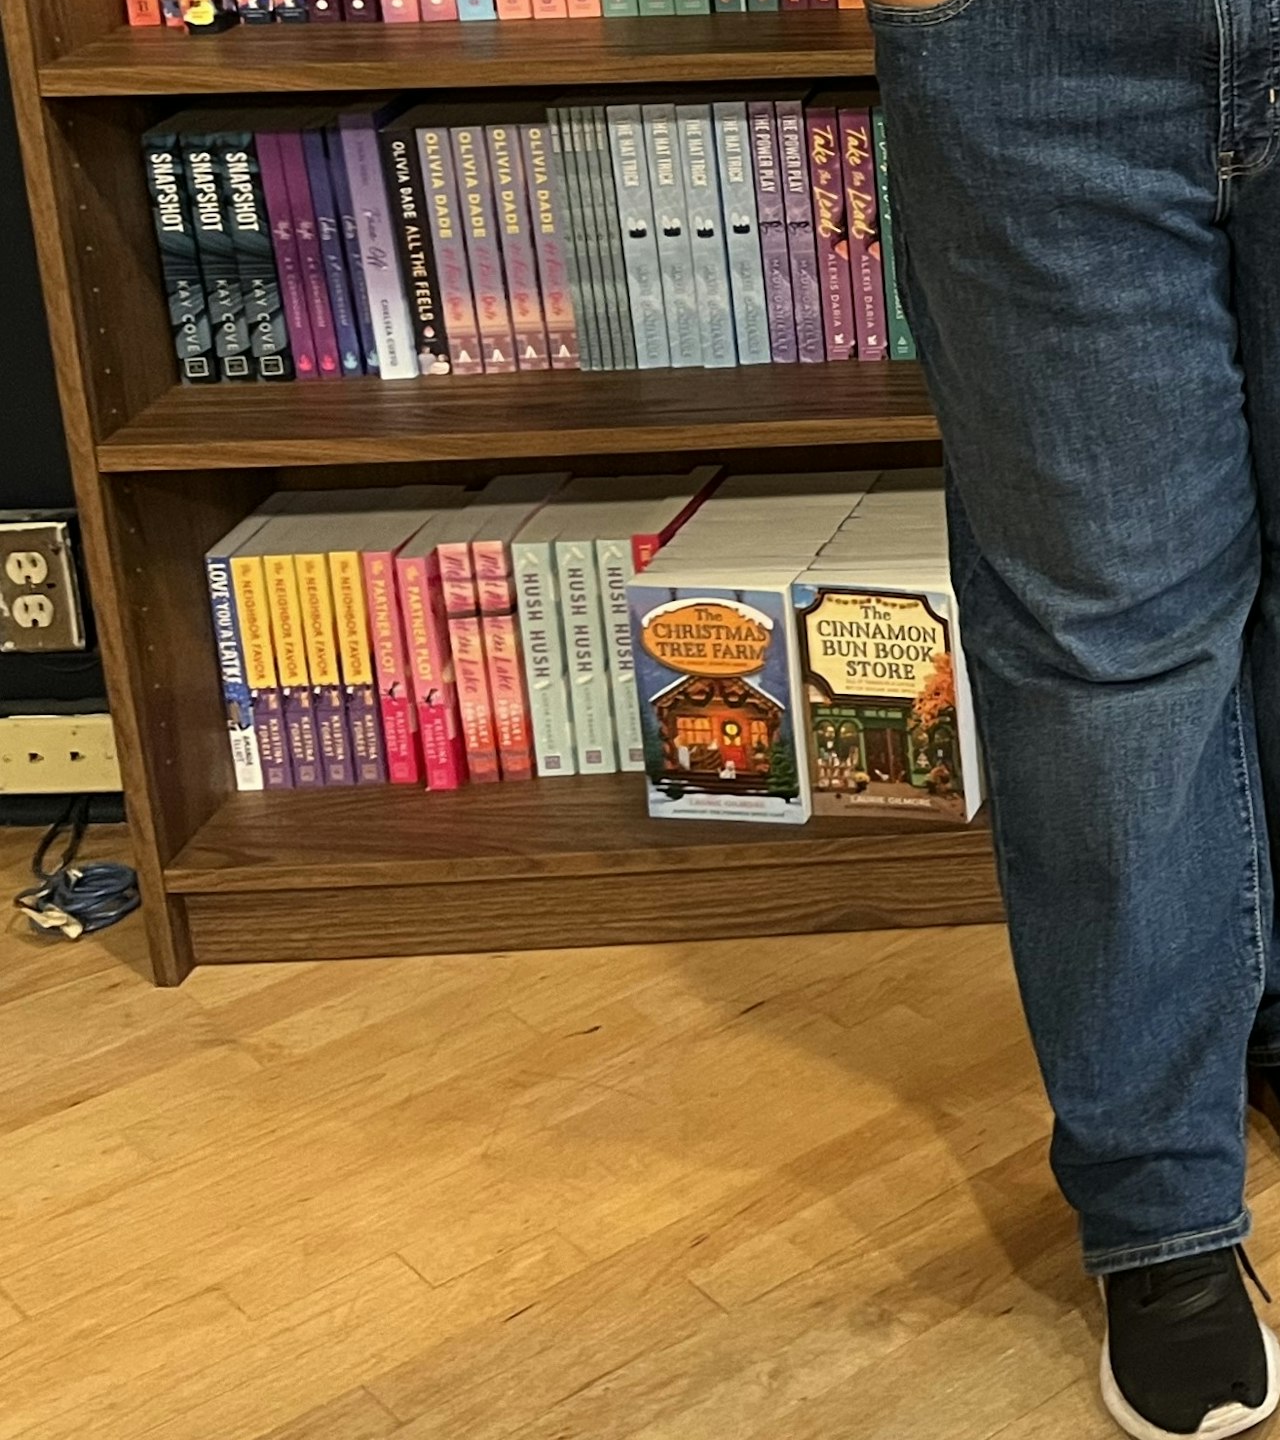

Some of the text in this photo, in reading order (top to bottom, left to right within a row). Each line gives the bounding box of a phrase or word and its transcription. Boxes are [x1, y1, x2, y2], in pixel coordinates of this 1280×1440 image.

[152, 154, 184, 232] SNAPSHOT
[693, 607, 723, 624] The
[860, 604, 891, 621] The
[525, 572, 553, 679] HUSH HUSH
[652, 621, 768, 644] CHRISTMAS
[815, 621, 937, 645] CINNAMON
[656, 641, 767, 661] TREE FARM
[823, 640, 935, 662] BUN BOOK
[845, 658, 915, 680] STORE
